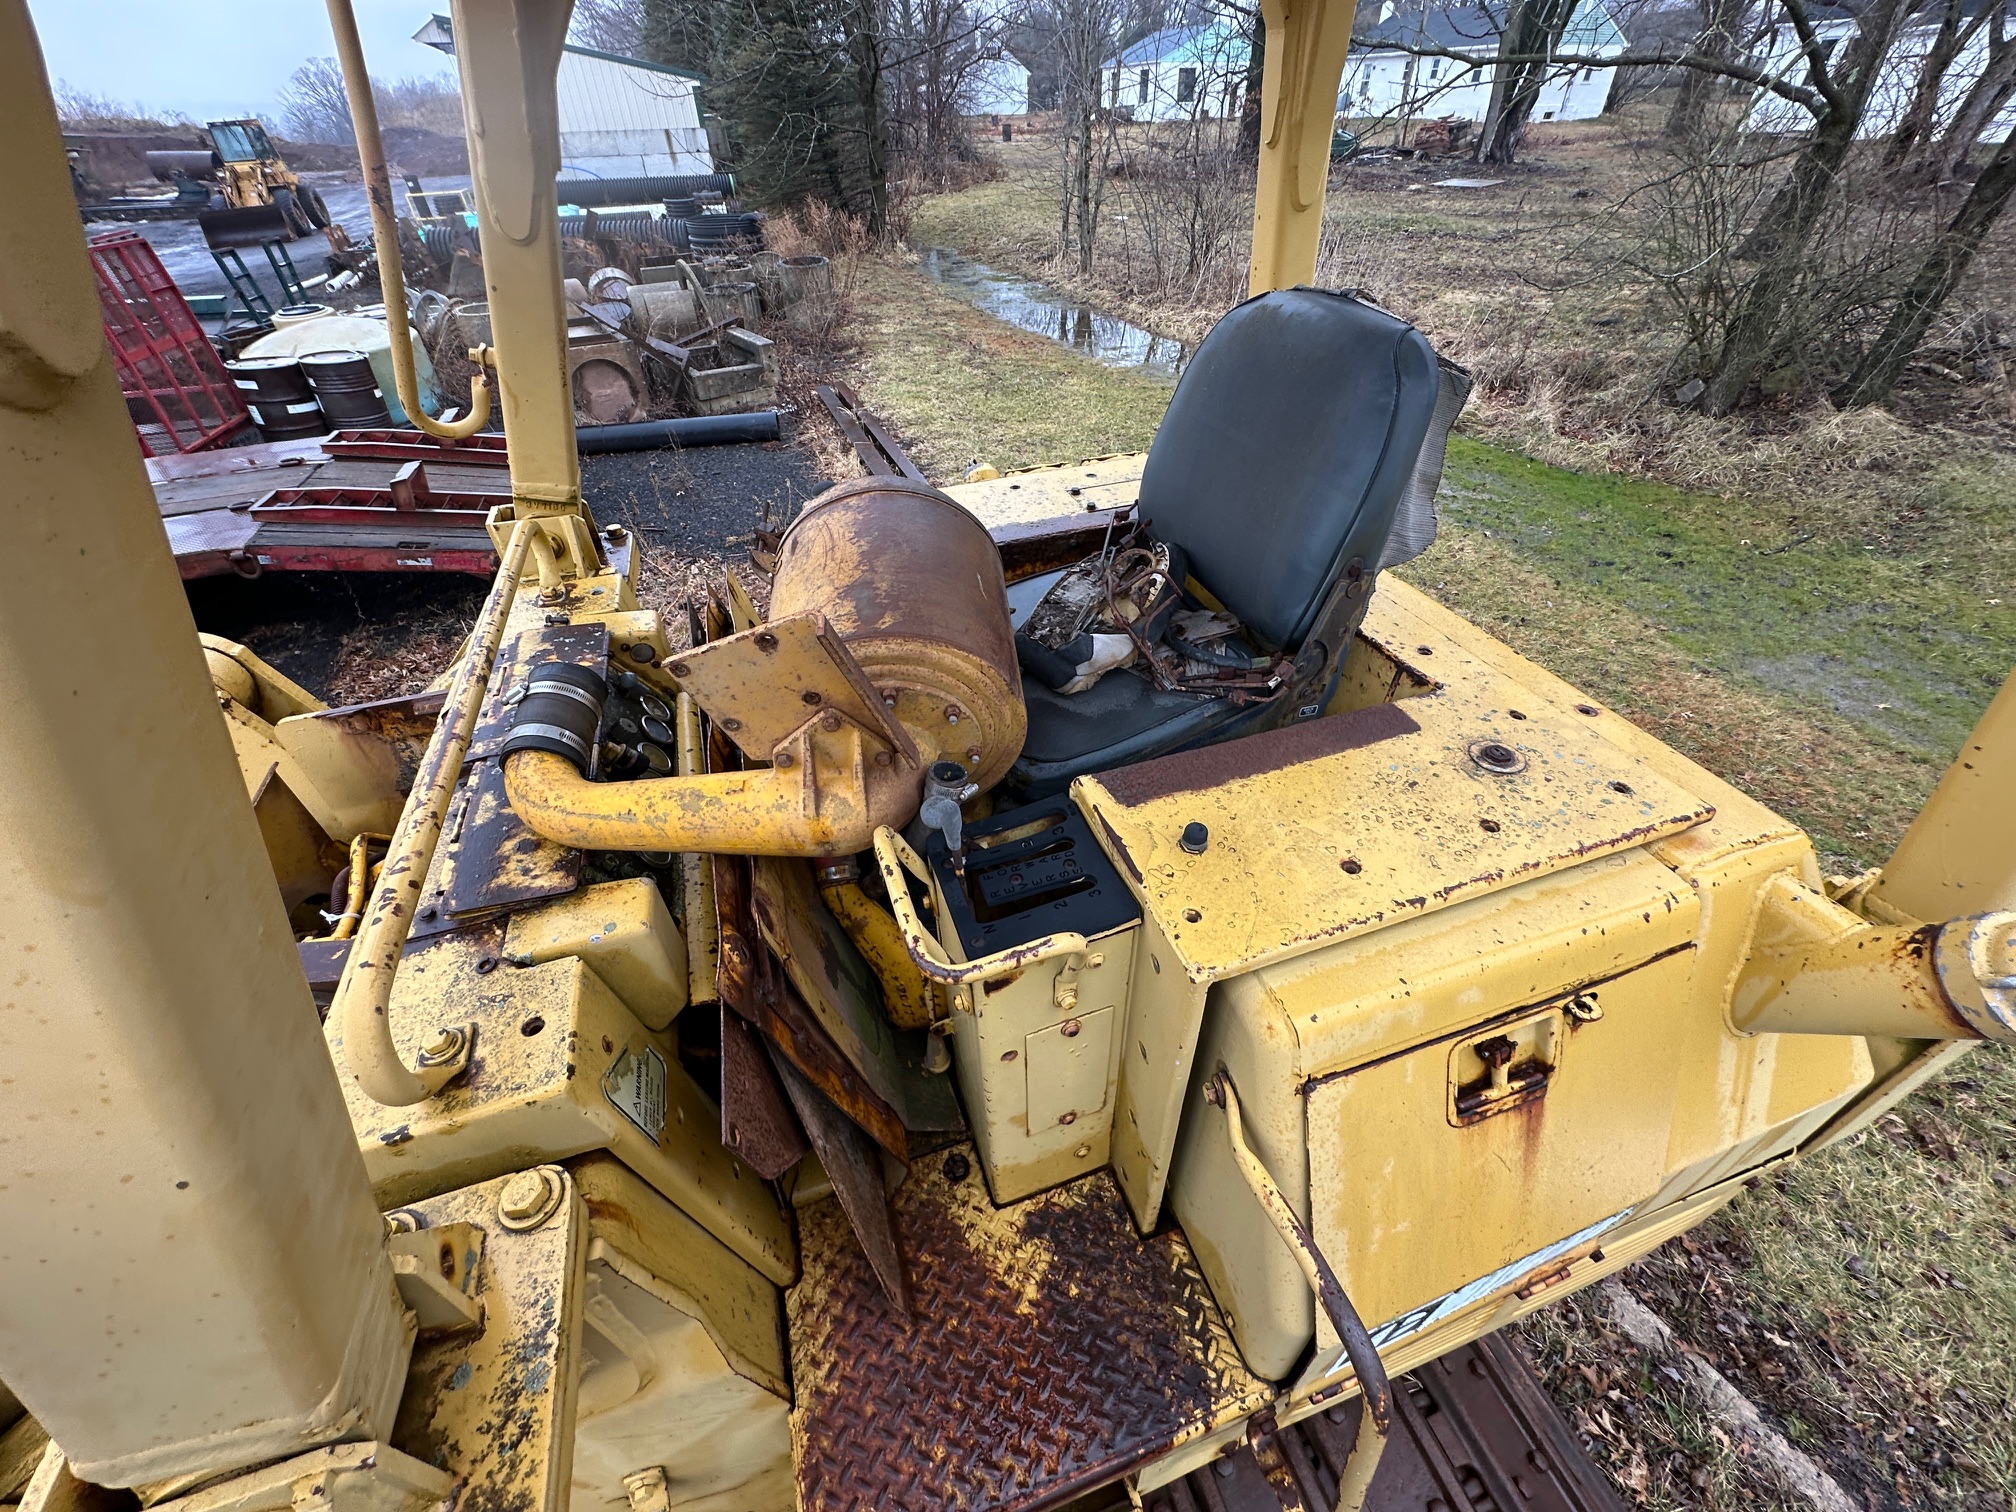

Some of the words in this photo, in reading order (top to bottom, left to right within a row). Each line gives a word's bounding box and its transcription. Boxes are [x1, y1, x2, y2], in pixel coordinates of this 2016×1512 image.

[1020, 839, 1035, 849] 2
[1052, 826, 1065, 836] 3
[983, 850, 1075, 881] FORWARD
[990, 866, 1083, 899] REVERSE
[1053, 900, 1068, 910] 2
[1088, 888, 1102, 898] 3
[635, 1056, 643, 1100] WARNING
